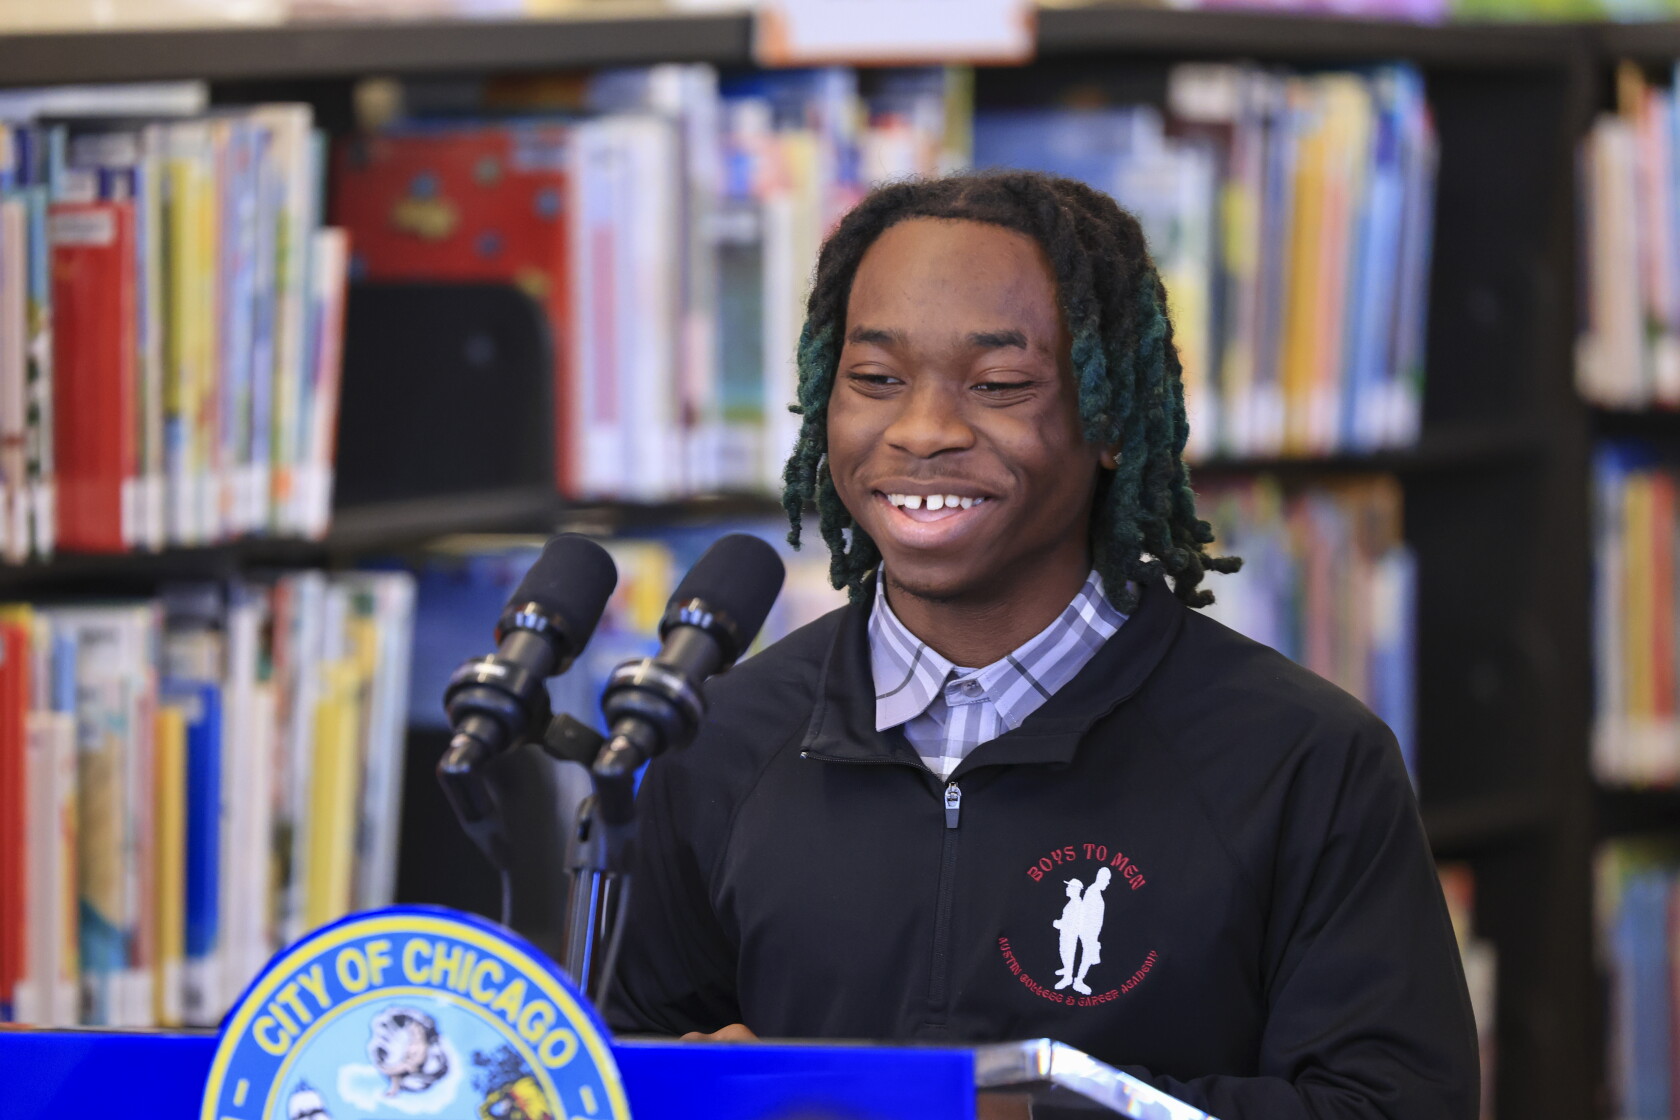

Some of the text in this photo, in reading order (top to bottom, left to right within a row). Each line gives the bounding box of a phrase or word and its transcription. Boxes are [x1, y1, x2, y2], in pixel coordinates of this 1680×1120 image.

[1027, 843, 1146, 890] BOYS TO MEN
[252, 938, 579, 1069] CITY OF CHICAGO
[998, 937, 1022, 976] AUSTIN
[1066, 996, 1075, 1006] &
[1078, 989, 1119, 1007] CAREER
[1121, 950, 1159, 994] ACADEMY
